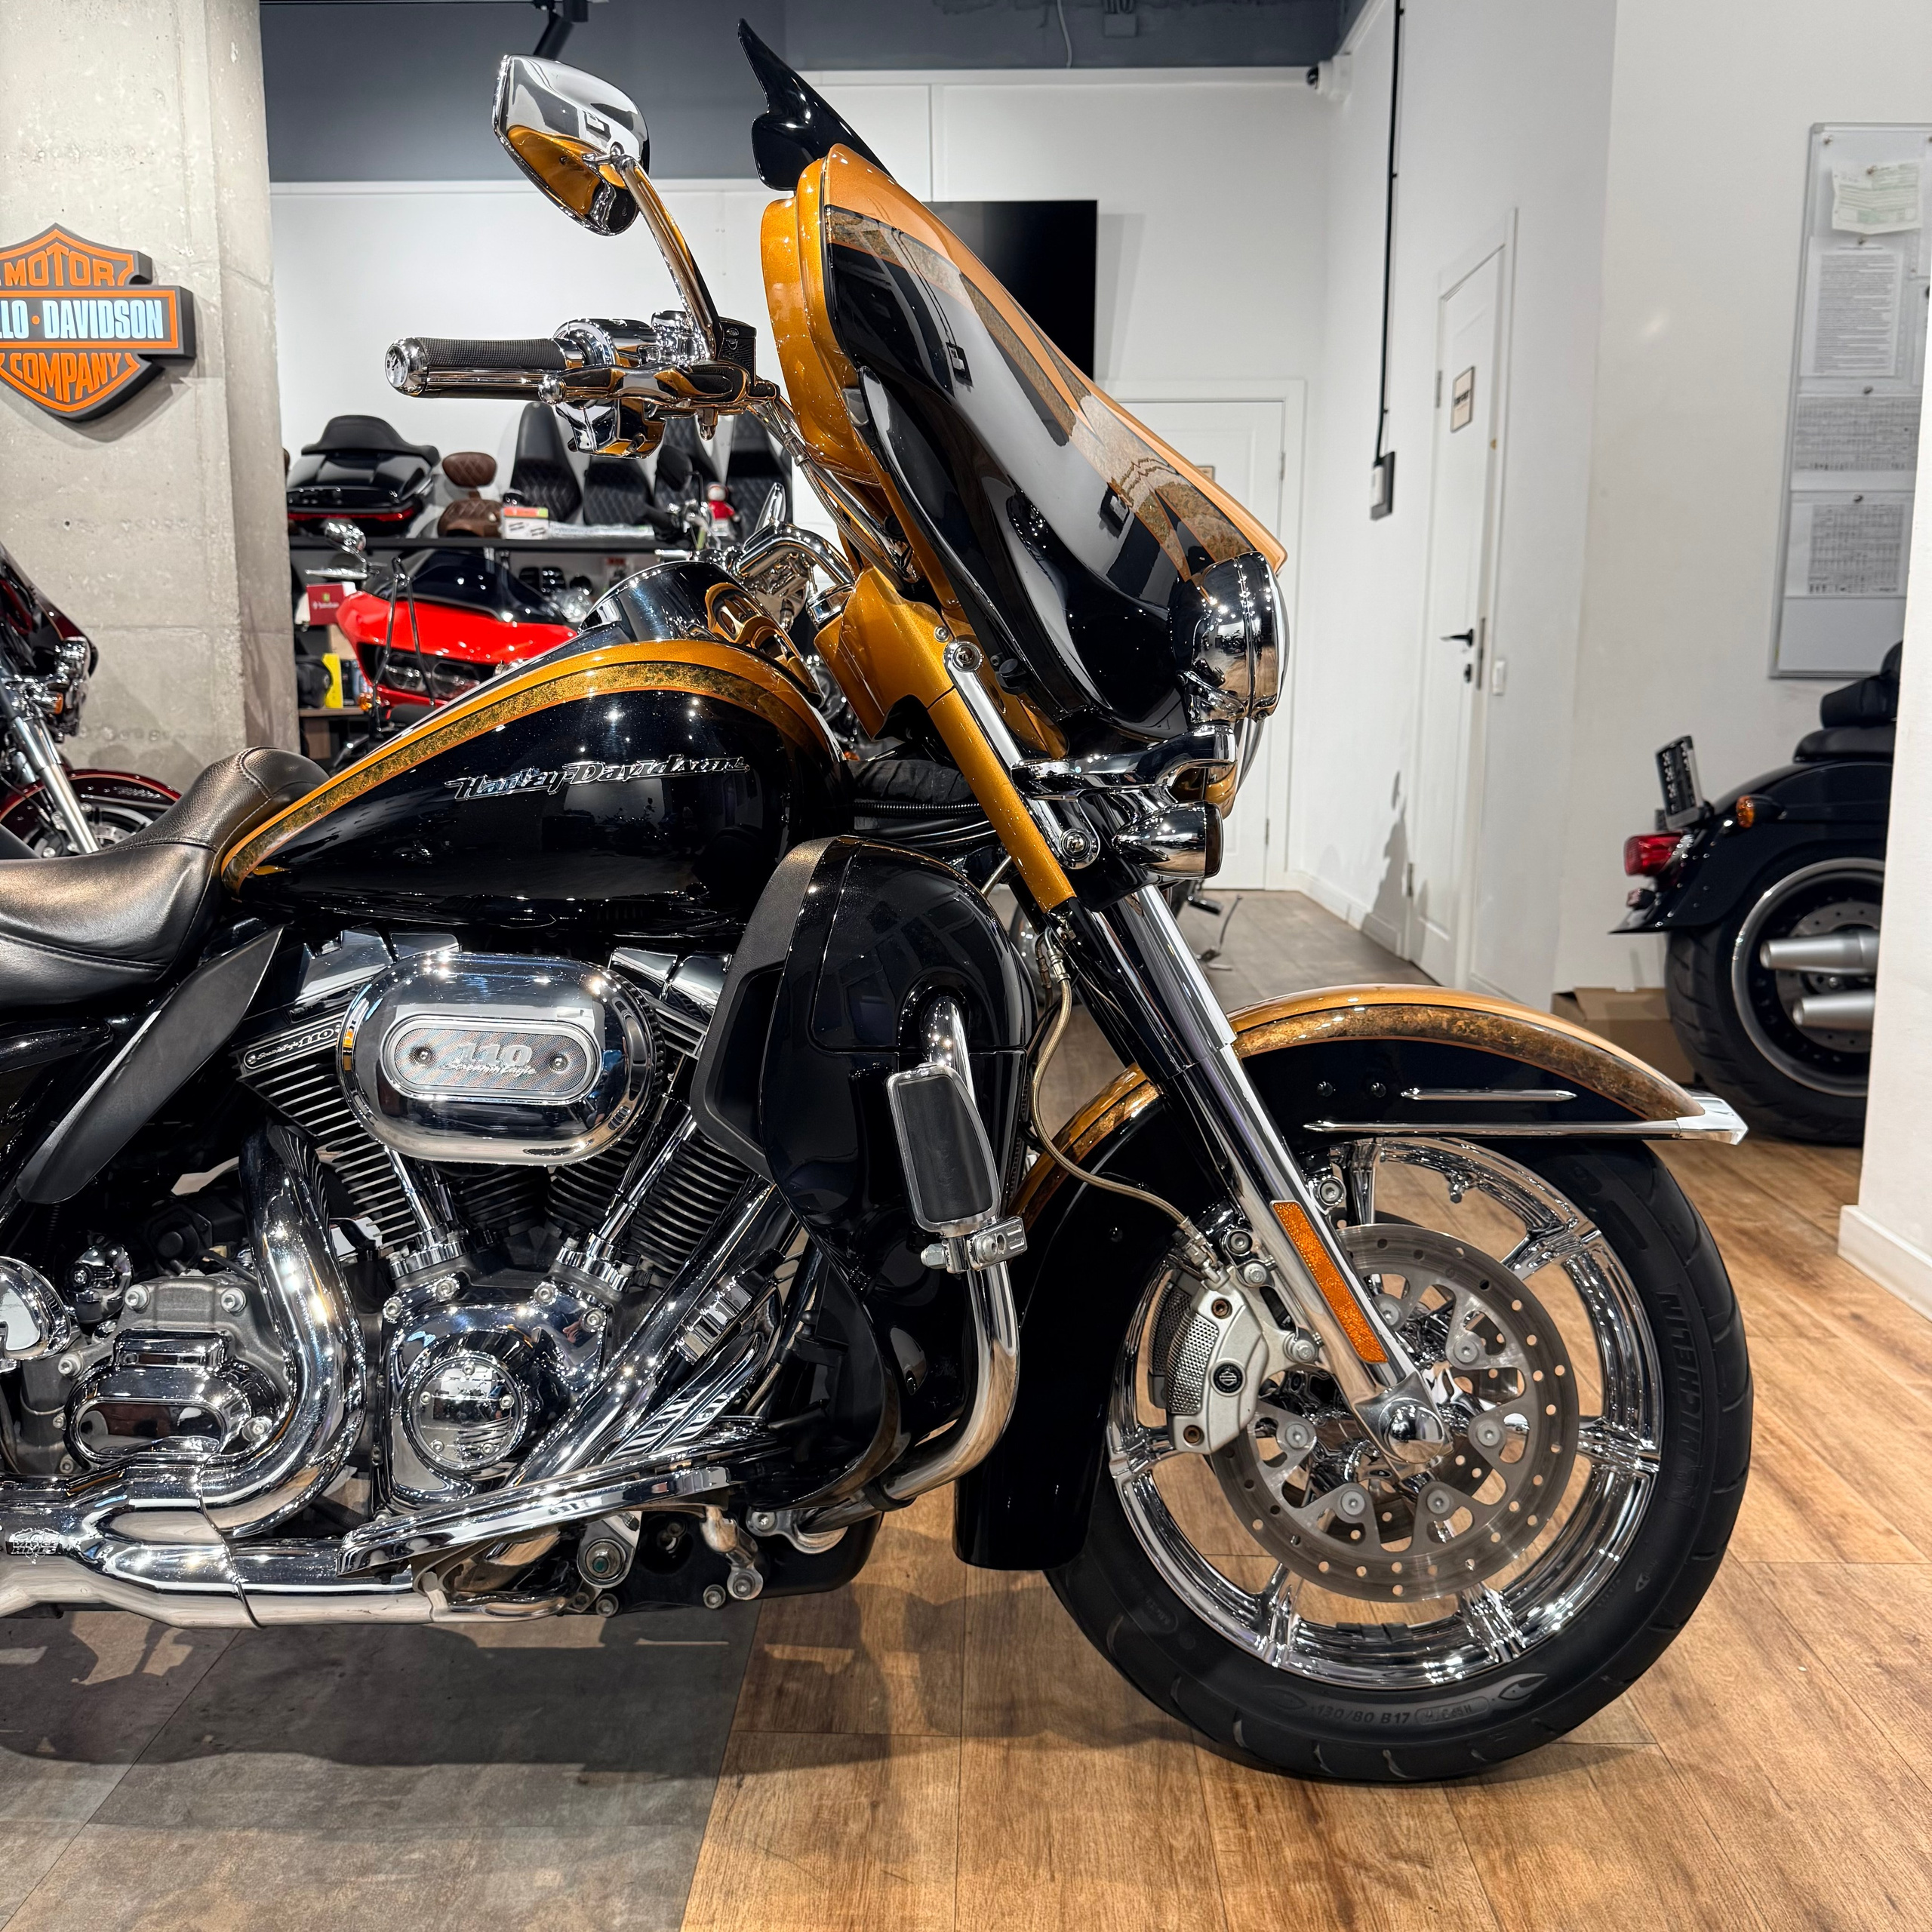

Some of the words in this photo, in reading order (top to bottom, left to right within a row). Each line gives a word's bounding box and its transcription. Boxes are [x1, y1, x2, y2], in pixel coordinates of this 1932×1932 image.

[5, 242, 115, 287] MOTOR
[42, 300, 164, 339] DAVIDSON
[9, 352, 122, 403] COMPANY
[457, 1041, 533, 1067] 110
[1657, 1291, 1701, 1463] MICHELIN
[1316, 1703, 1374, 1724] 130/80
